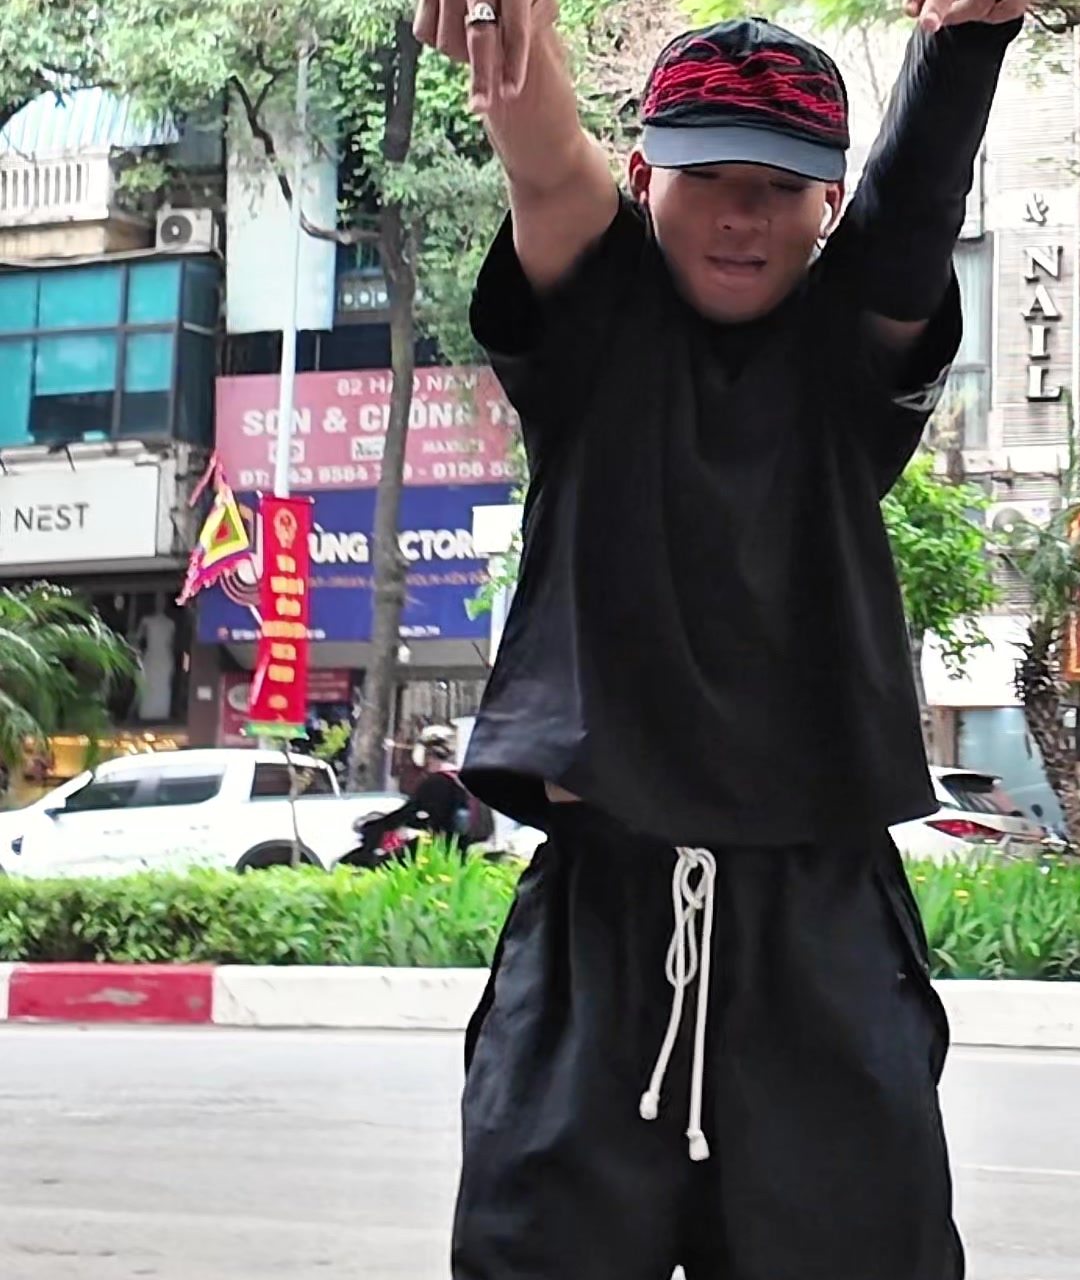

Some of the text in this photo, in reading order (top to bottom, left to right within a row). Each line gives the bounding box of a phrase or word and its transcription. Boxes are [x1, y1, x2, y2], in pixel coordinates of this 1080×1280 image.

[1021, 245, 1063, 402] NAIL
[322, 406, 347, 434] &
[14, 502, 90, 532] NEST
[307, 522, 369, 564] ÙNG
